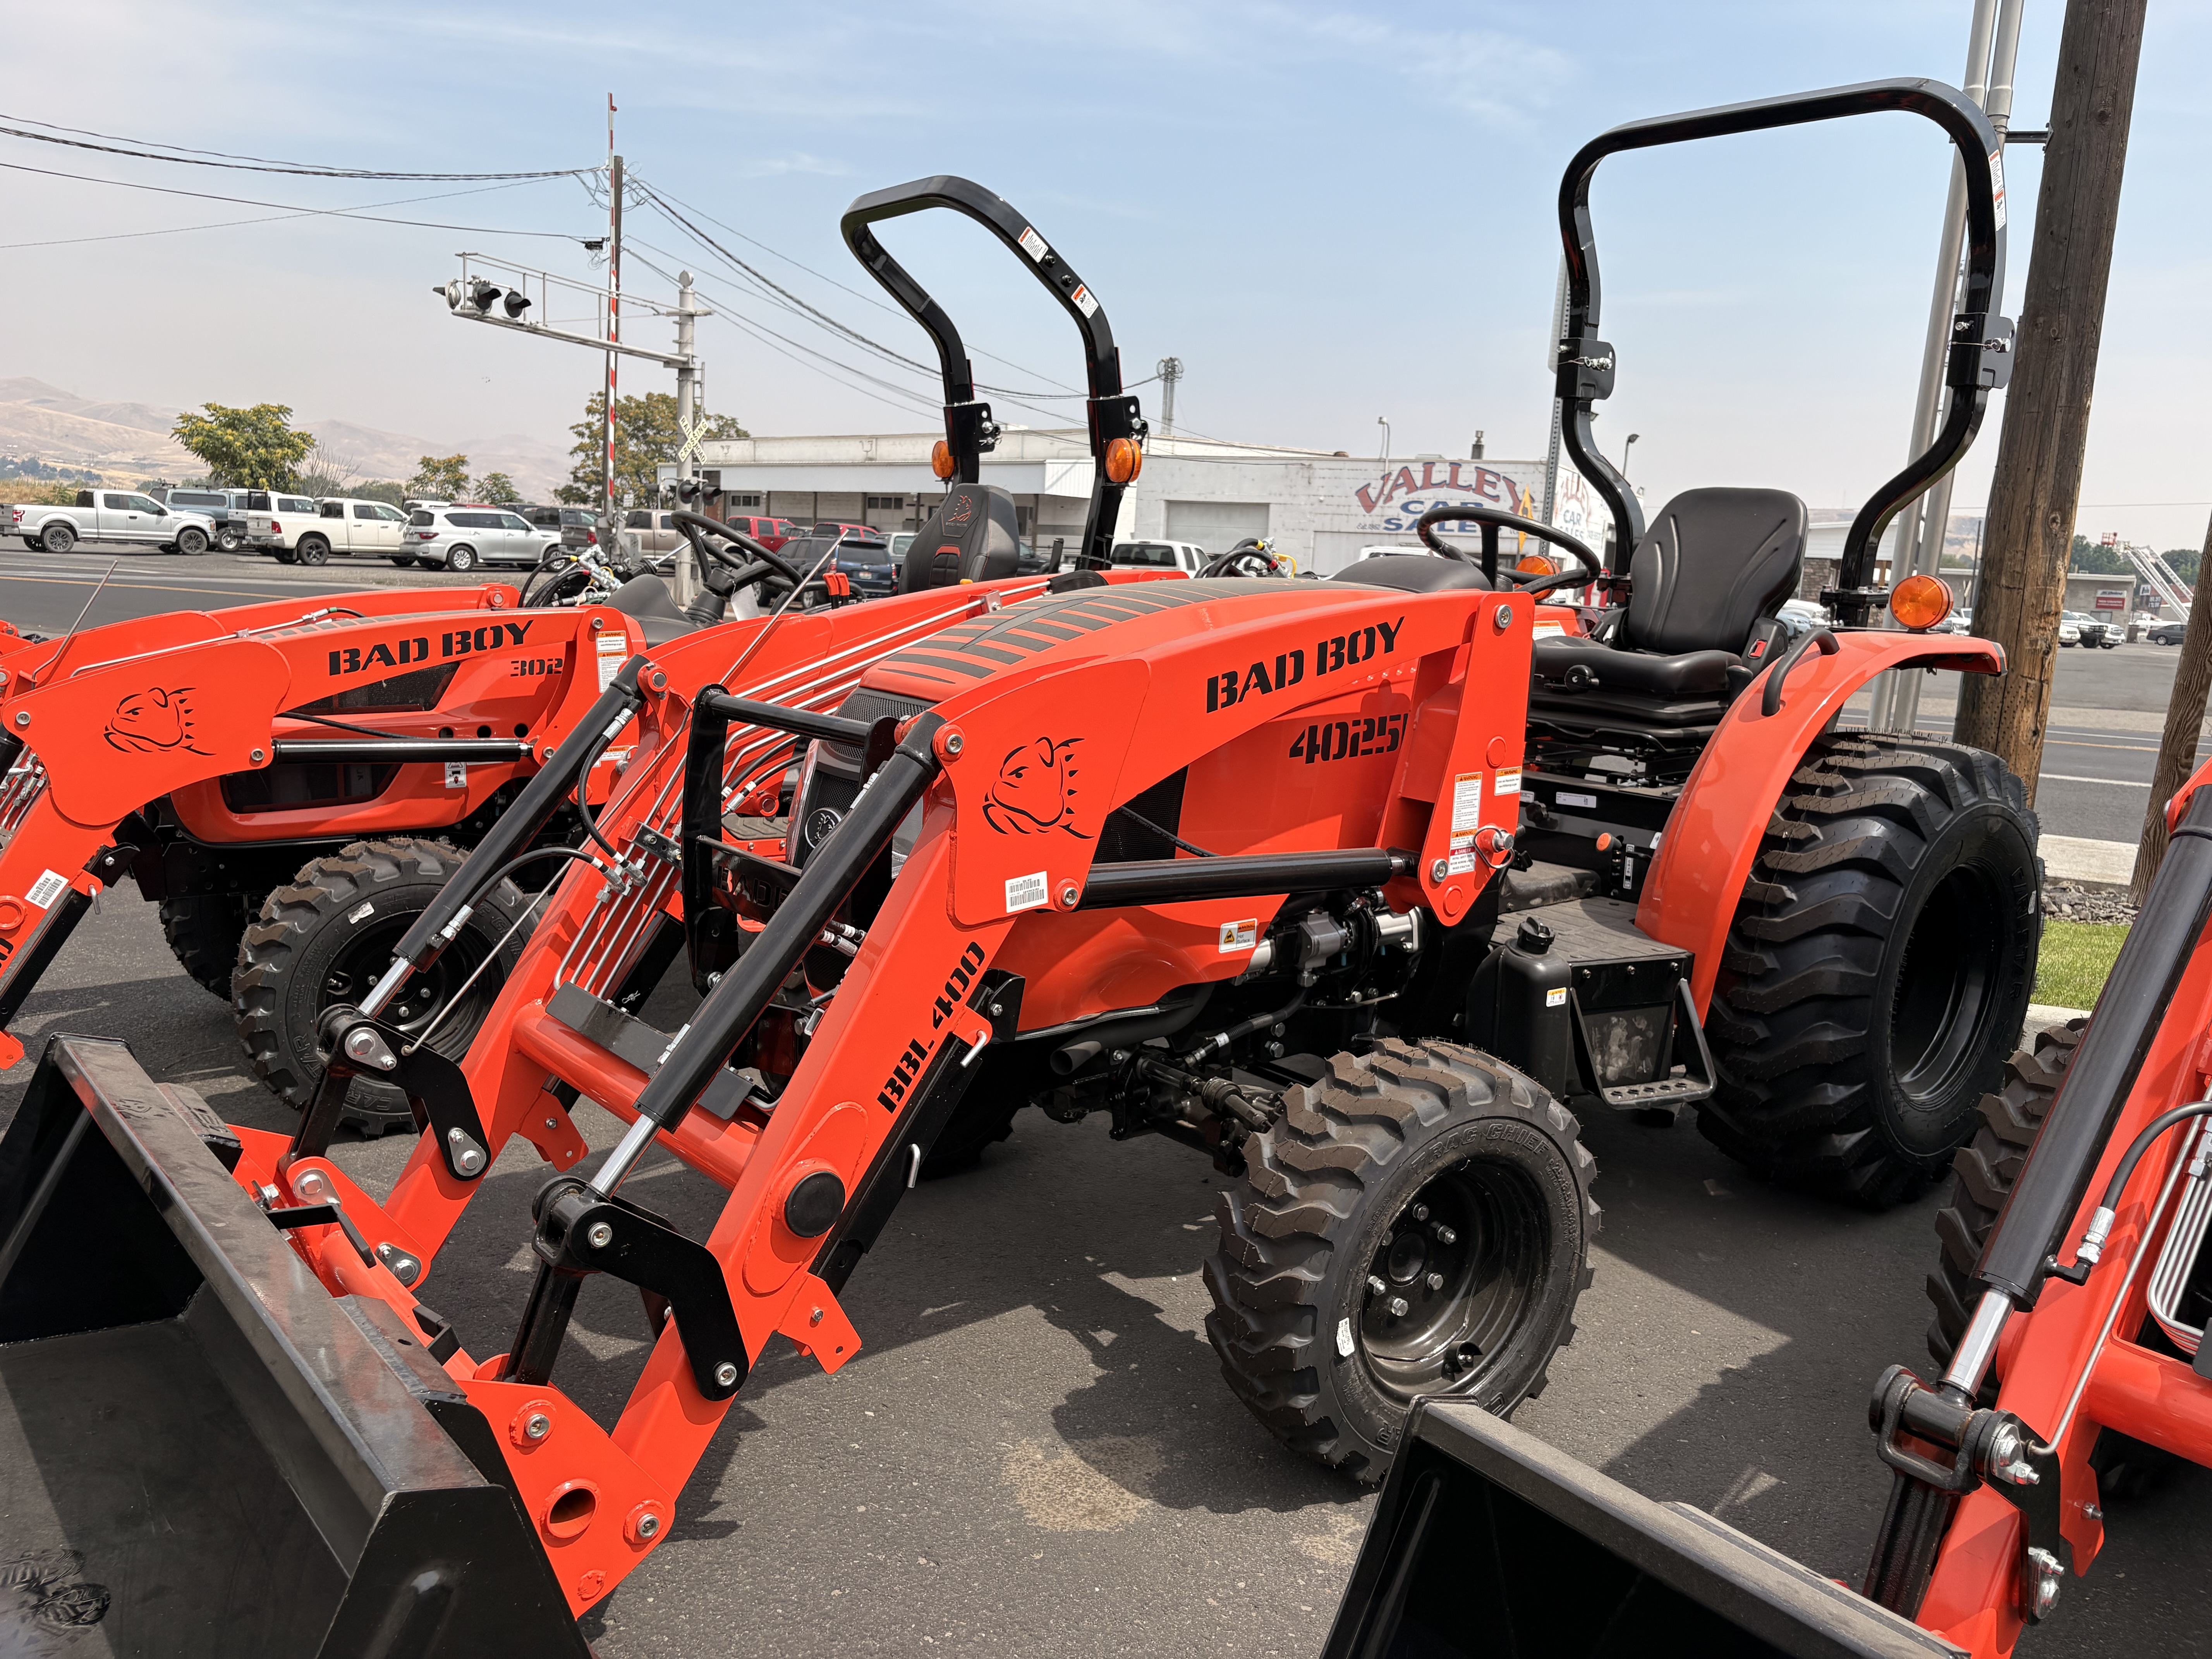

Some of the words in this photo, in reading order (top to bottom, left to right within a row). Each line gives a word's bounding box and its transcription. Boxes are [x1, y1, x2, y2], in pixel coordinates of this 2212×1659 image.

[680, 421, 707, 459] CROSSING
[681, 417, 691, 438] RAIL
[1355, 462, 1535, 514] VALLEY
[329, 637, 429, 676] BAD
[442, 620, 534, 657] BOY
[1207, 649, 1304, 713] BAD
[1317, 617, 1405, 677] BOY
[933, 941, 986, 1030] 400
[1486, 1123, 1551, 1155] CHIEF
[1367, 1197, 1391, 1232] DIRECTION
